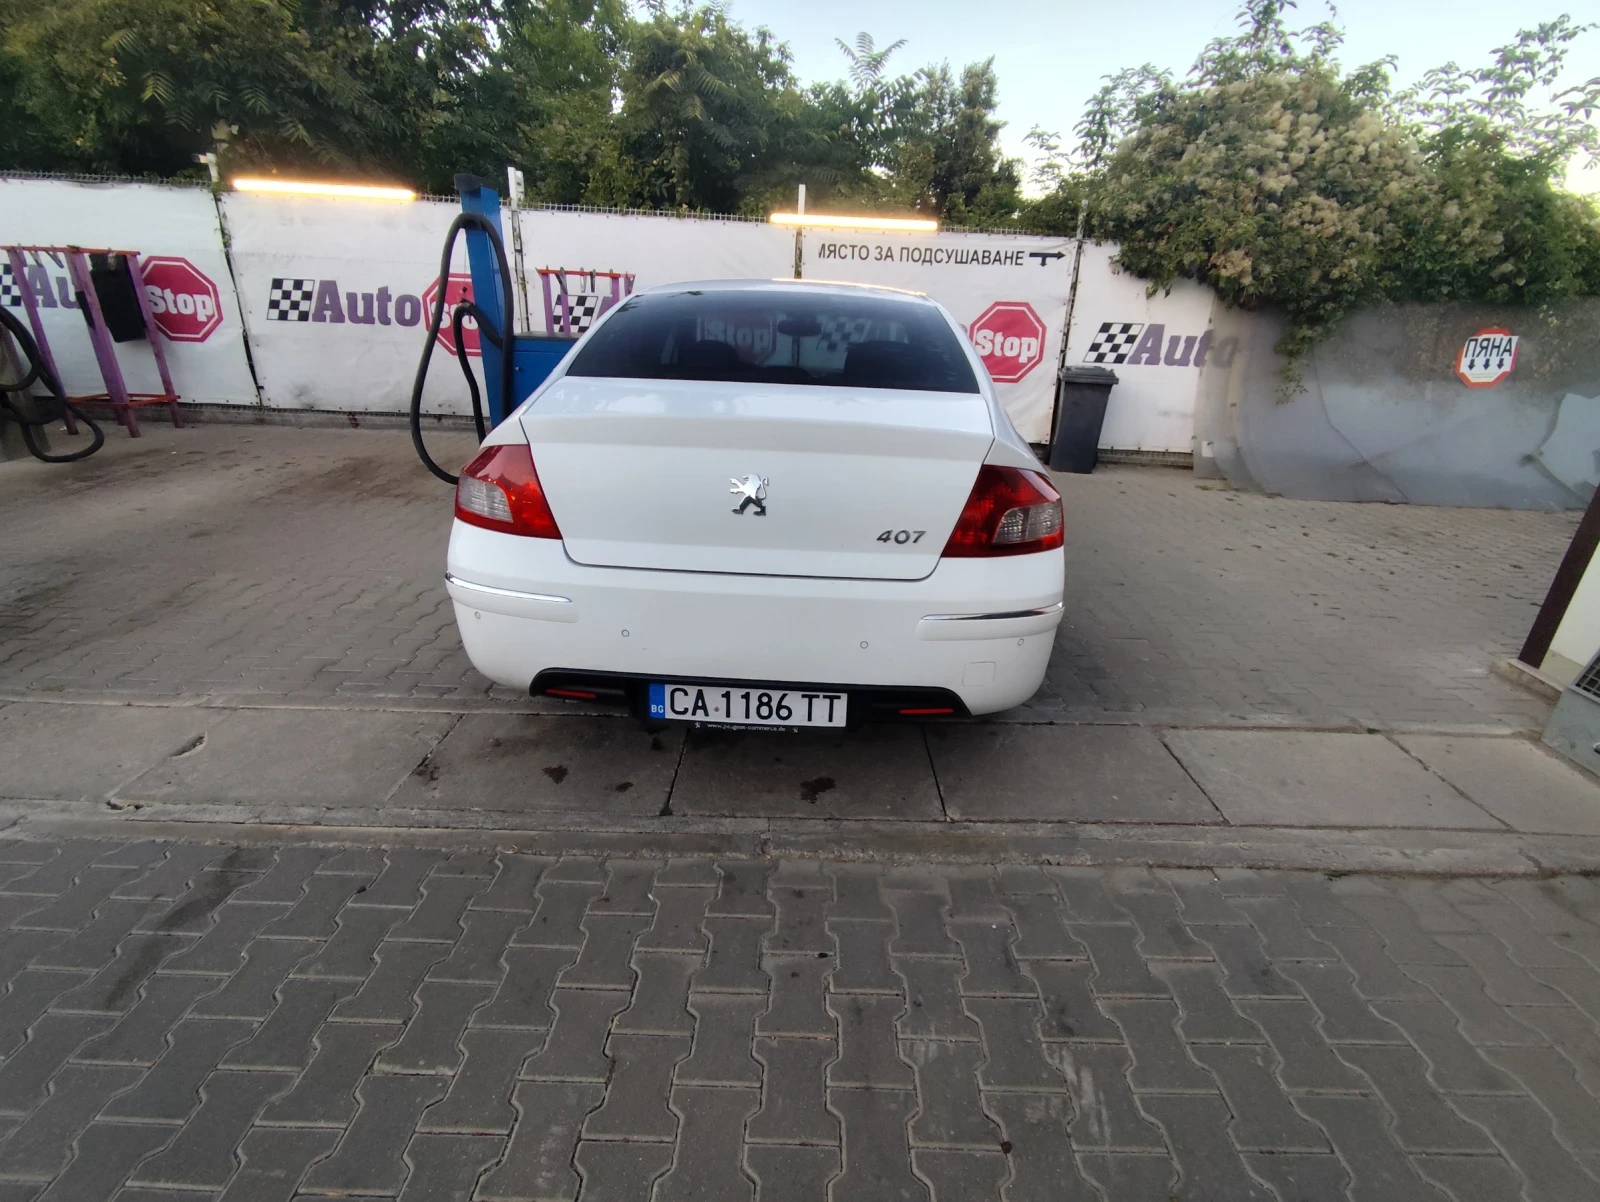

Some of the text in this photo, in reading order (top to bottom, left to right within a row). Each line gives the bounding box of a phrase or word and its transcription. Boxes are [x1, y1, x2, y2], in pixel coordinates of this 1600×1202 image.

[874, 245, 895, 262] ЗА
[899, 246, 1025, 267] ПОДСУШАВАНЕ
[145, 284, 214, 322] Stop
[311, 280, 421, 327] Auto
[974, 329, 1038, 363] Stop
[1127, 323, 1239, 369] Auto
[1464, 337, 1512, 358] ПЯНА
[876, 529, 926, 545] 407
[650, 704, 664, 714] BG
[669, 687, 842, 723] CA 1186 TT
